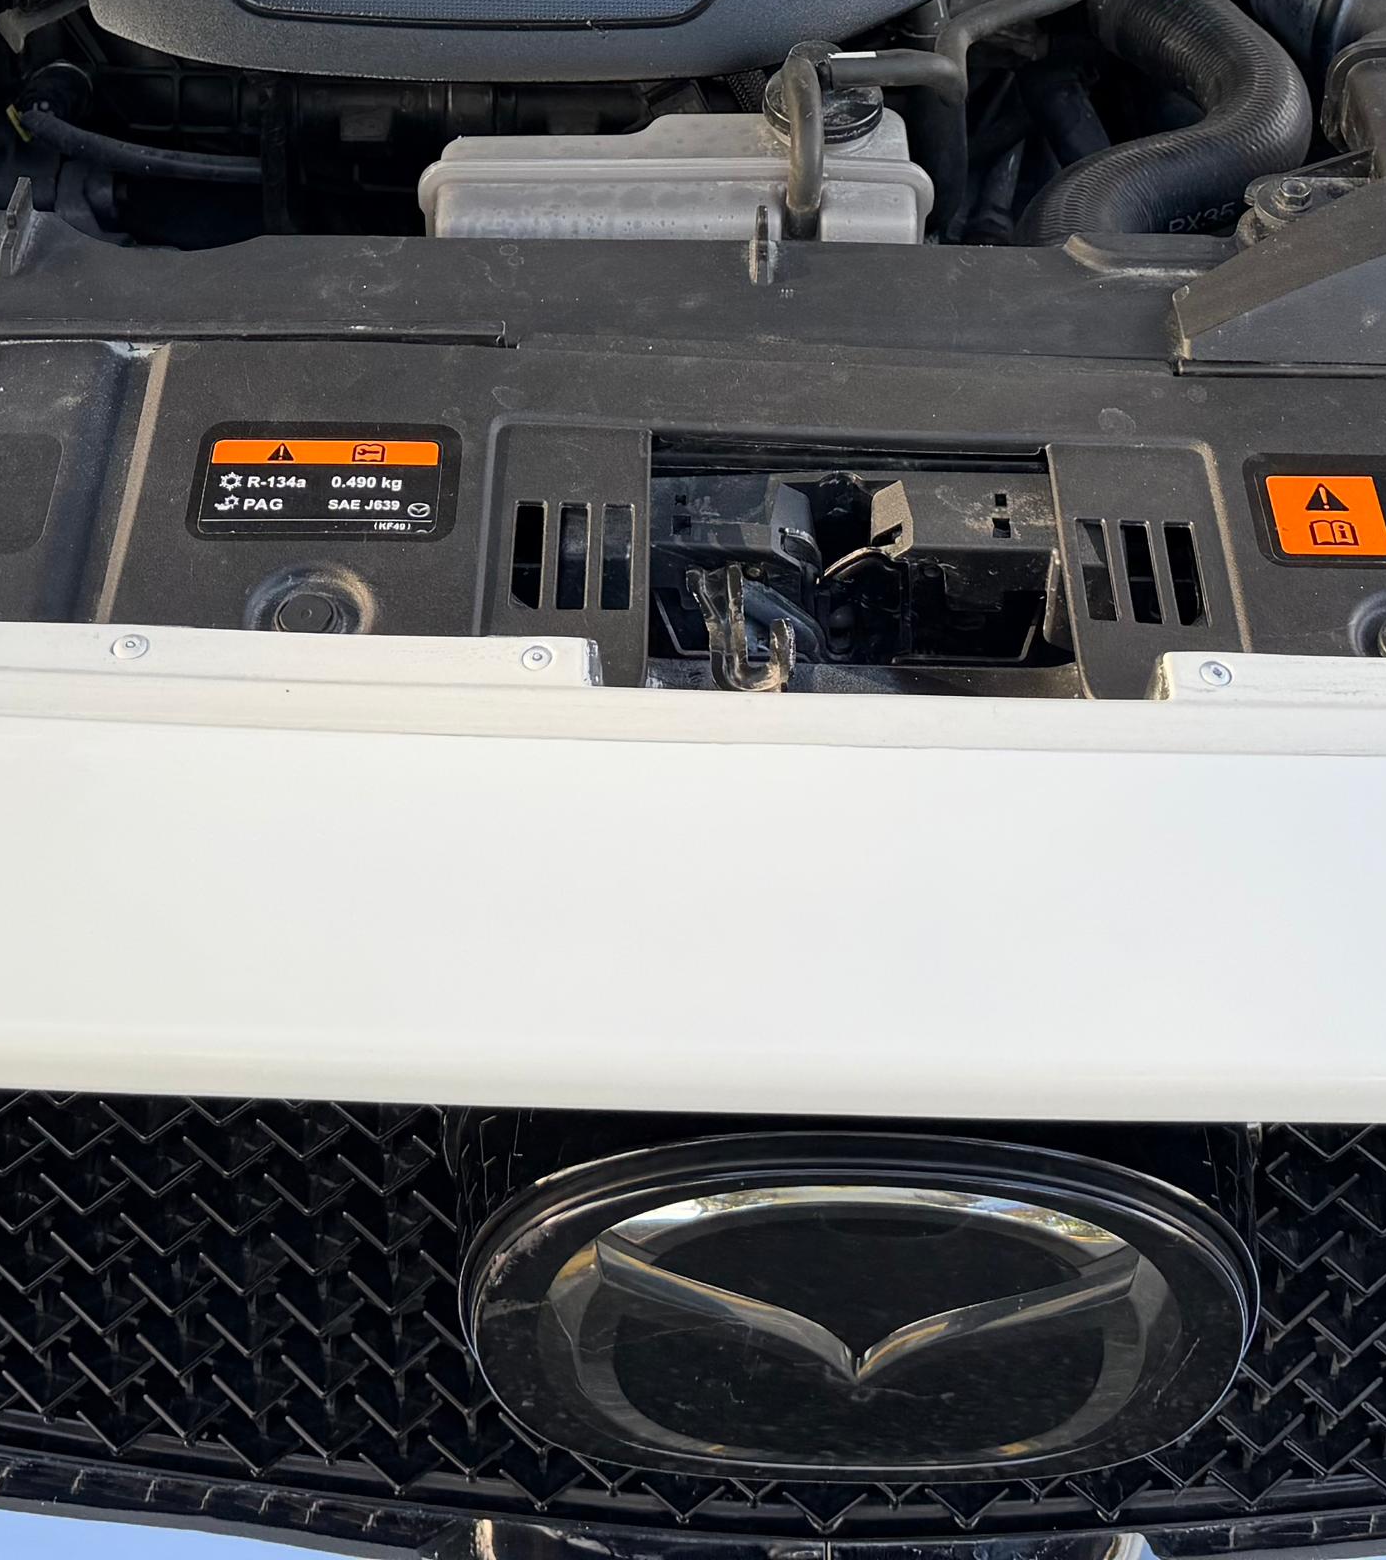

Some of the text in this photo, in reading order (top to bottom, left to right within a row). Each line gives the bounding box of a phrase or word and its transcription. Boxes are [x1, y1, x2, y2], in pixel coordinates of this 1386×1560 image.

[246, 475, 403, 491] R-134a 0.490 kg
[243, 498, 401, 511] PAG SAE J639
